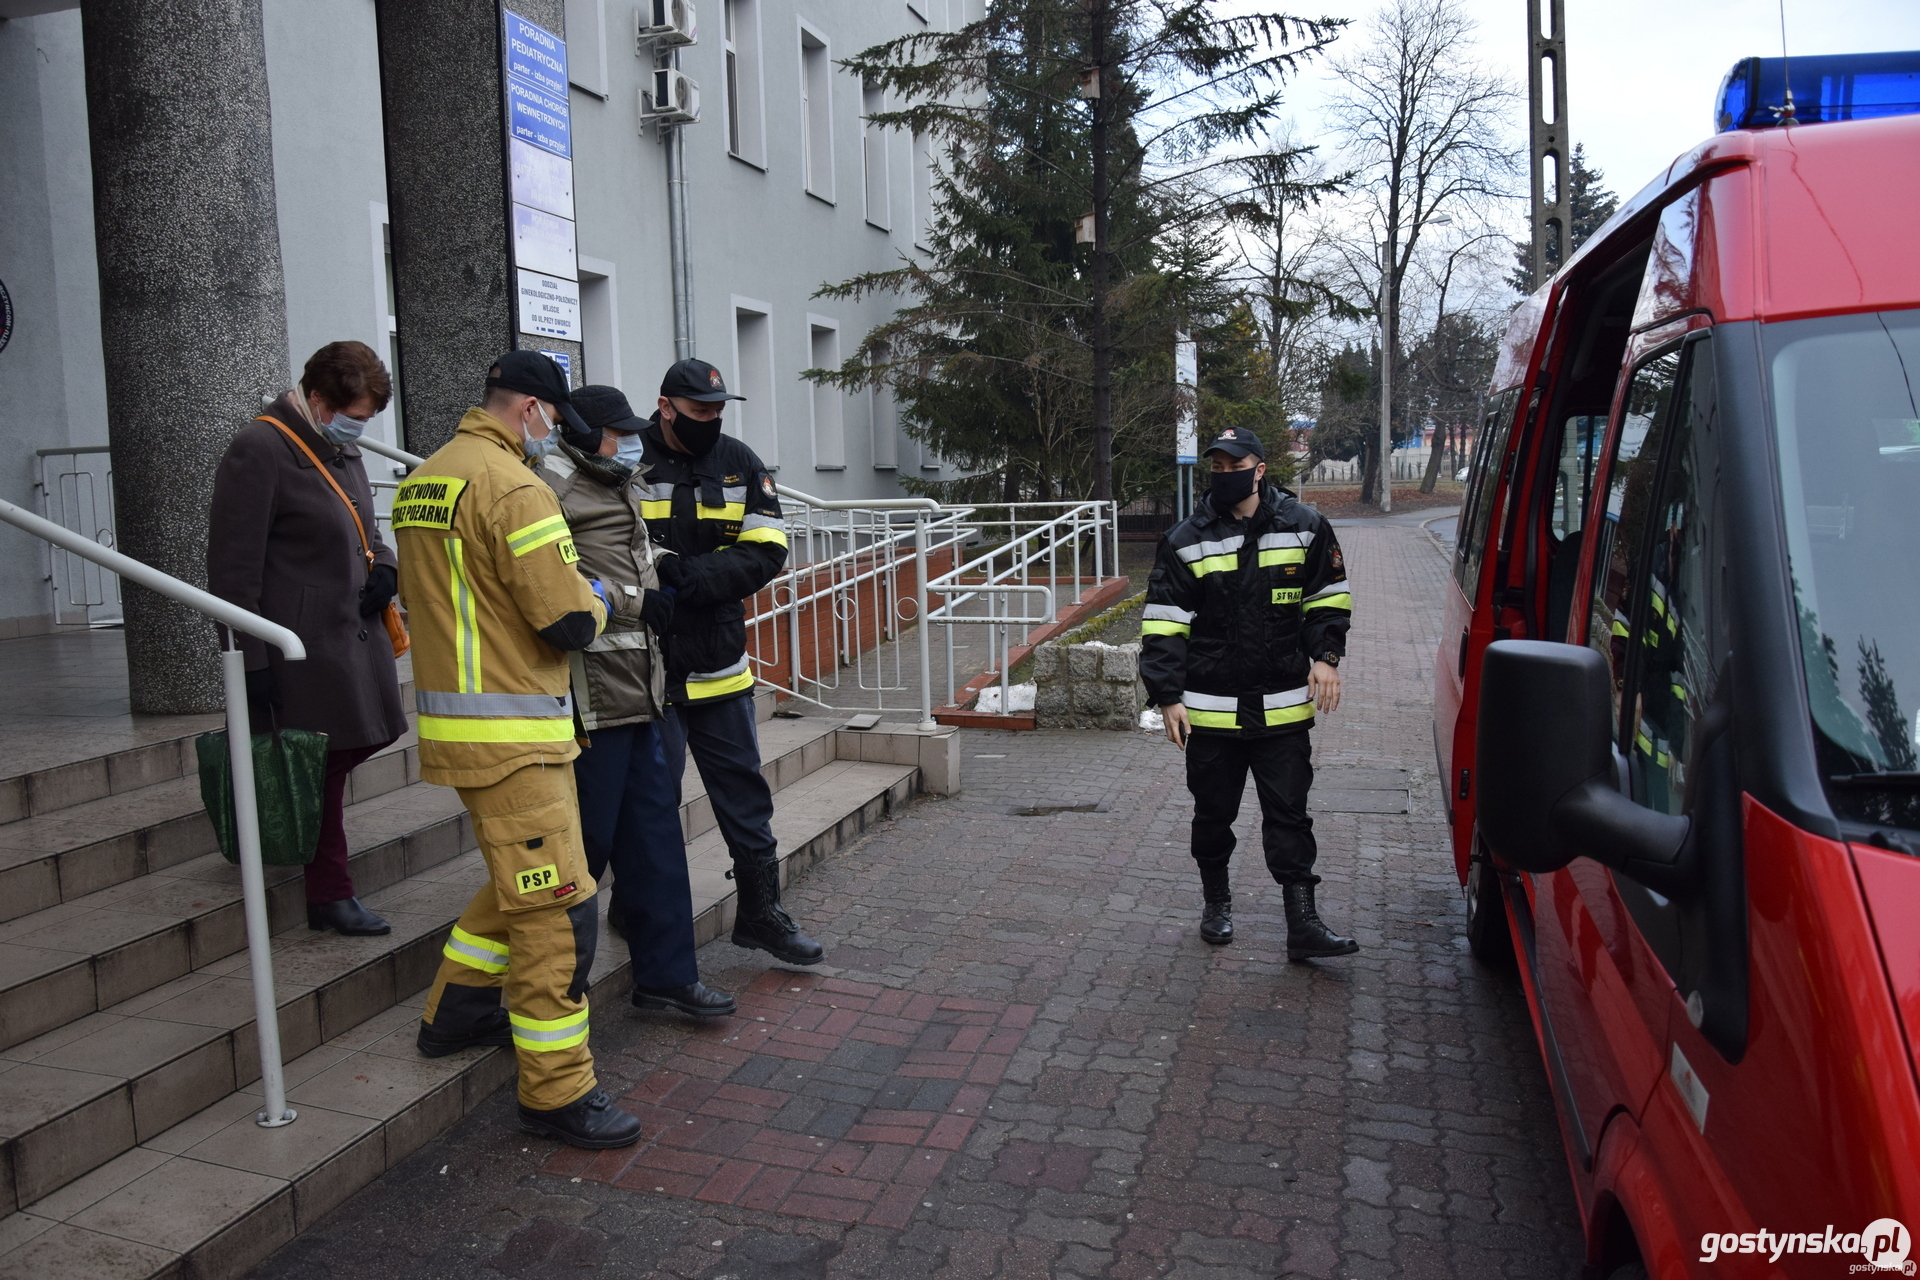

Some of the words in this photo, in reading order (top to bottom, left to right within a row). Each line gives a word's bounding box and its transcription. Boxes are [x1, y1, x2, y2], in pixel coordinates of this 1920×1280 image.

[519, 22, 556, 52] PORADNIA
[511, 37, 564, 75] PEDIATRYCZNA
[513, 61, 531, 75] parter
[534, 70, 545, 83] izba
[546, 77, 563, 92] przyjęć
[510, 83, 544, 106] PORADNIA
[543, 98, 568, 118] CHORÓB
[516, 101, 566, 131] WEWNĘTRZNYCH
[516, 126, 534, 138] parter
[537, 132, 549, 145] izba
[548, 138, 566, 152] przyjęć
[542, 280, 558, 290] ODDZIAŁ
[542, 303, 560, 314] WEJŚCIE
[554, 318, 571, 328] DWORCU
[405, 504, 450, 524] POŻARNA
[521, 869, 552, 889] PSP
